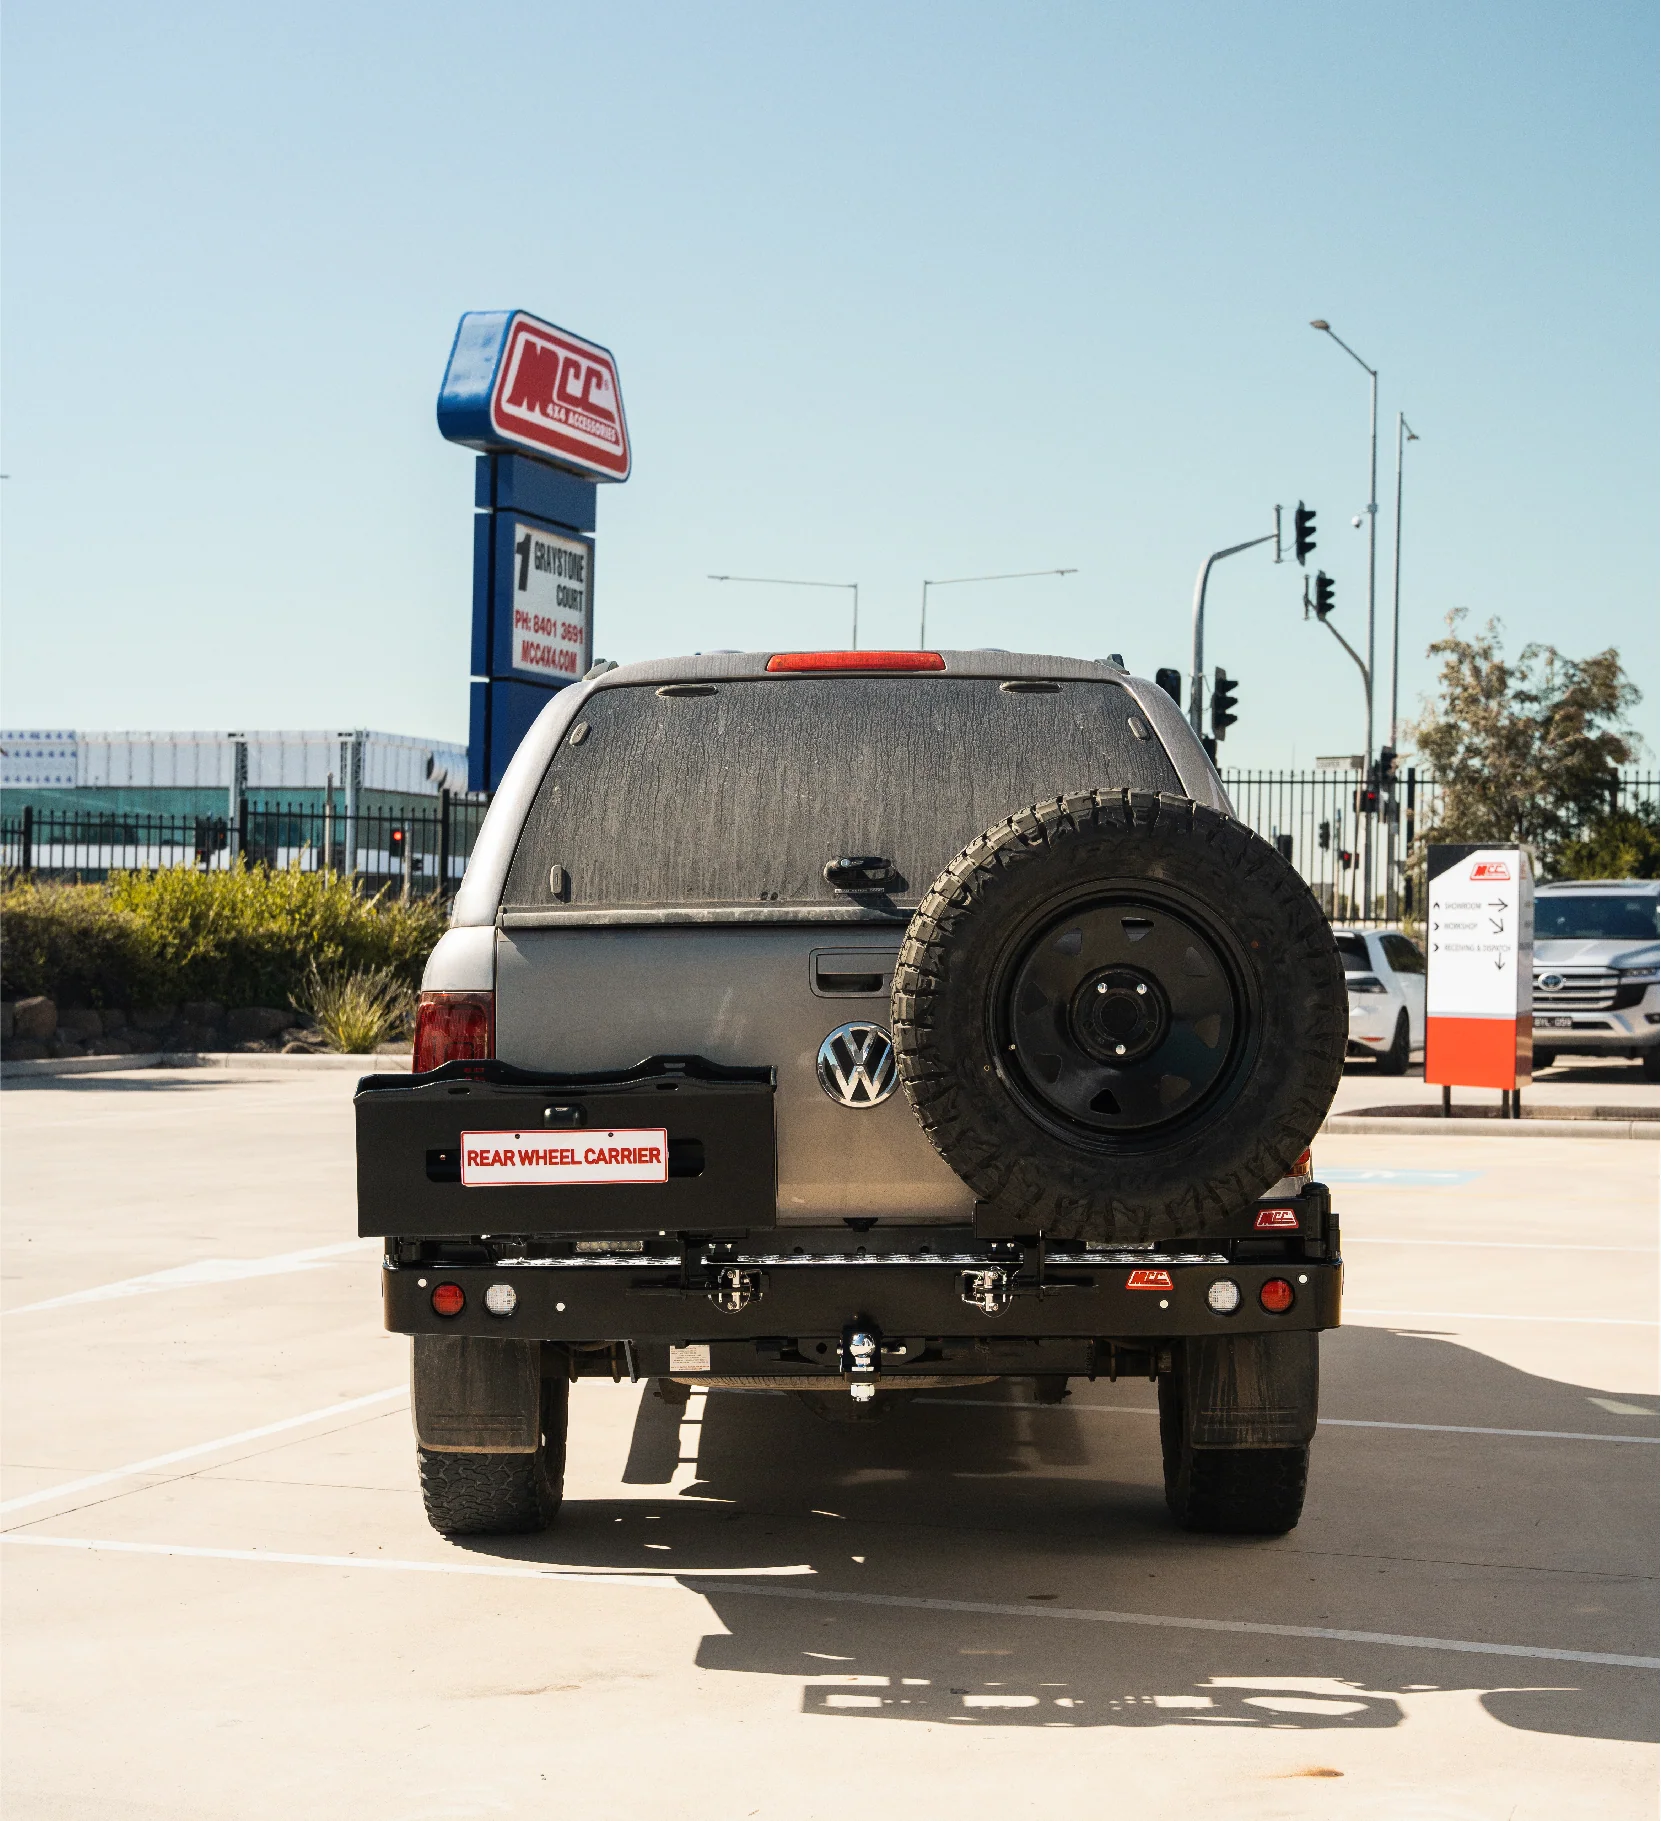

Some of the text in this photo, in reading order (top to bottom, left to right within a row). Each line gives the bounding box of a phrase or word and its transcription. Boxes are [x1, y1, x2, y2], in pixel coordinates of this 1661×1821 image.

[506, 339, 616, 426] MCC
[568, 412, 617, 442] ACCESSORIES
[516, 533, 584, 592] 1 GRAYSTONE
[556, 584, 584, 612] COURT
[515, 609, 584, 645] PH: 8401 3691
[521, 640, 577, 674] MCC4X4.COM
[1444, 902, 1481, 910] SHOWROOM
[467, 1147, 661, 1167] REAR WHEEL CARRIER
